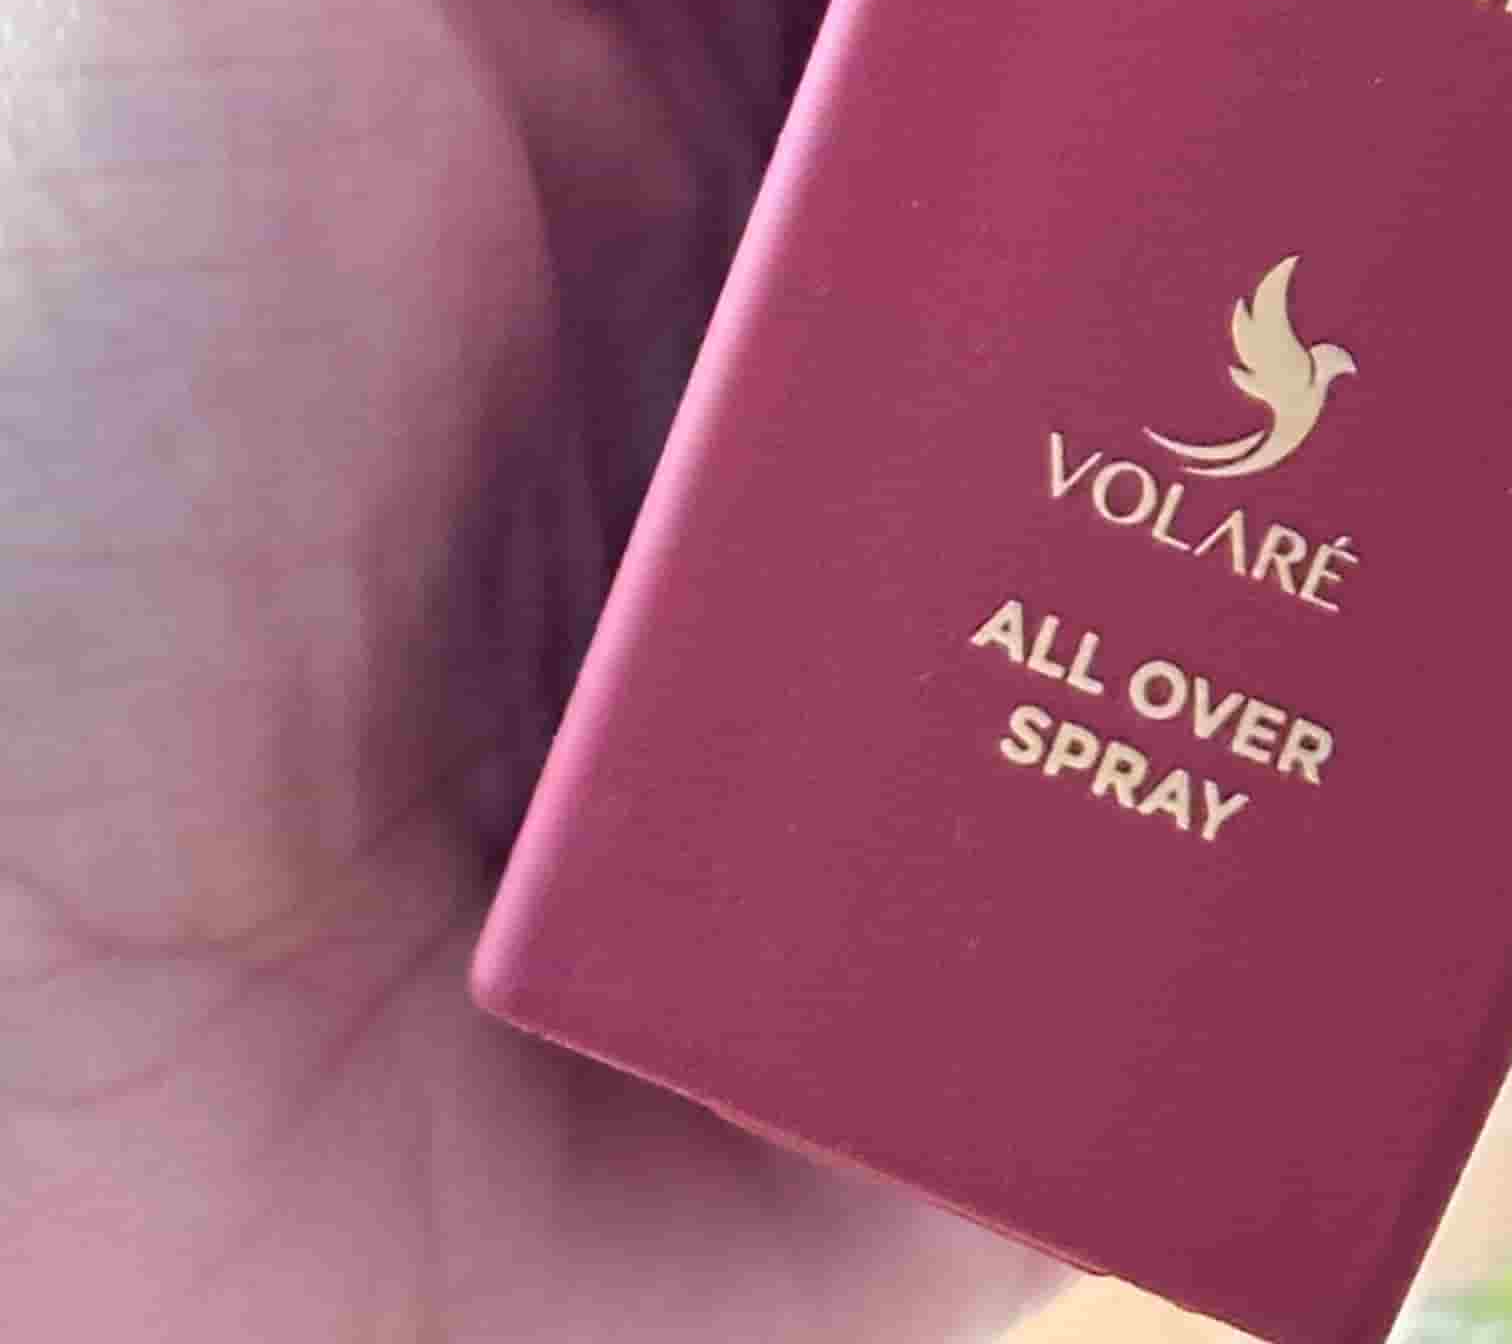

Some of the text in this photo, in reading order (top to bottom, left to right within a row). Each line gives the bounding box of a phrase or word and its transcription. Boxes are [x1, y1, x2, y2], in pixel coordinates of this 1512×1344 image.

[1048, 430, 1359, 613] VOLARÉ
[969, 598, 1335, 786] ALL OVER
[998, 703, 1251, 843] SPRAY
